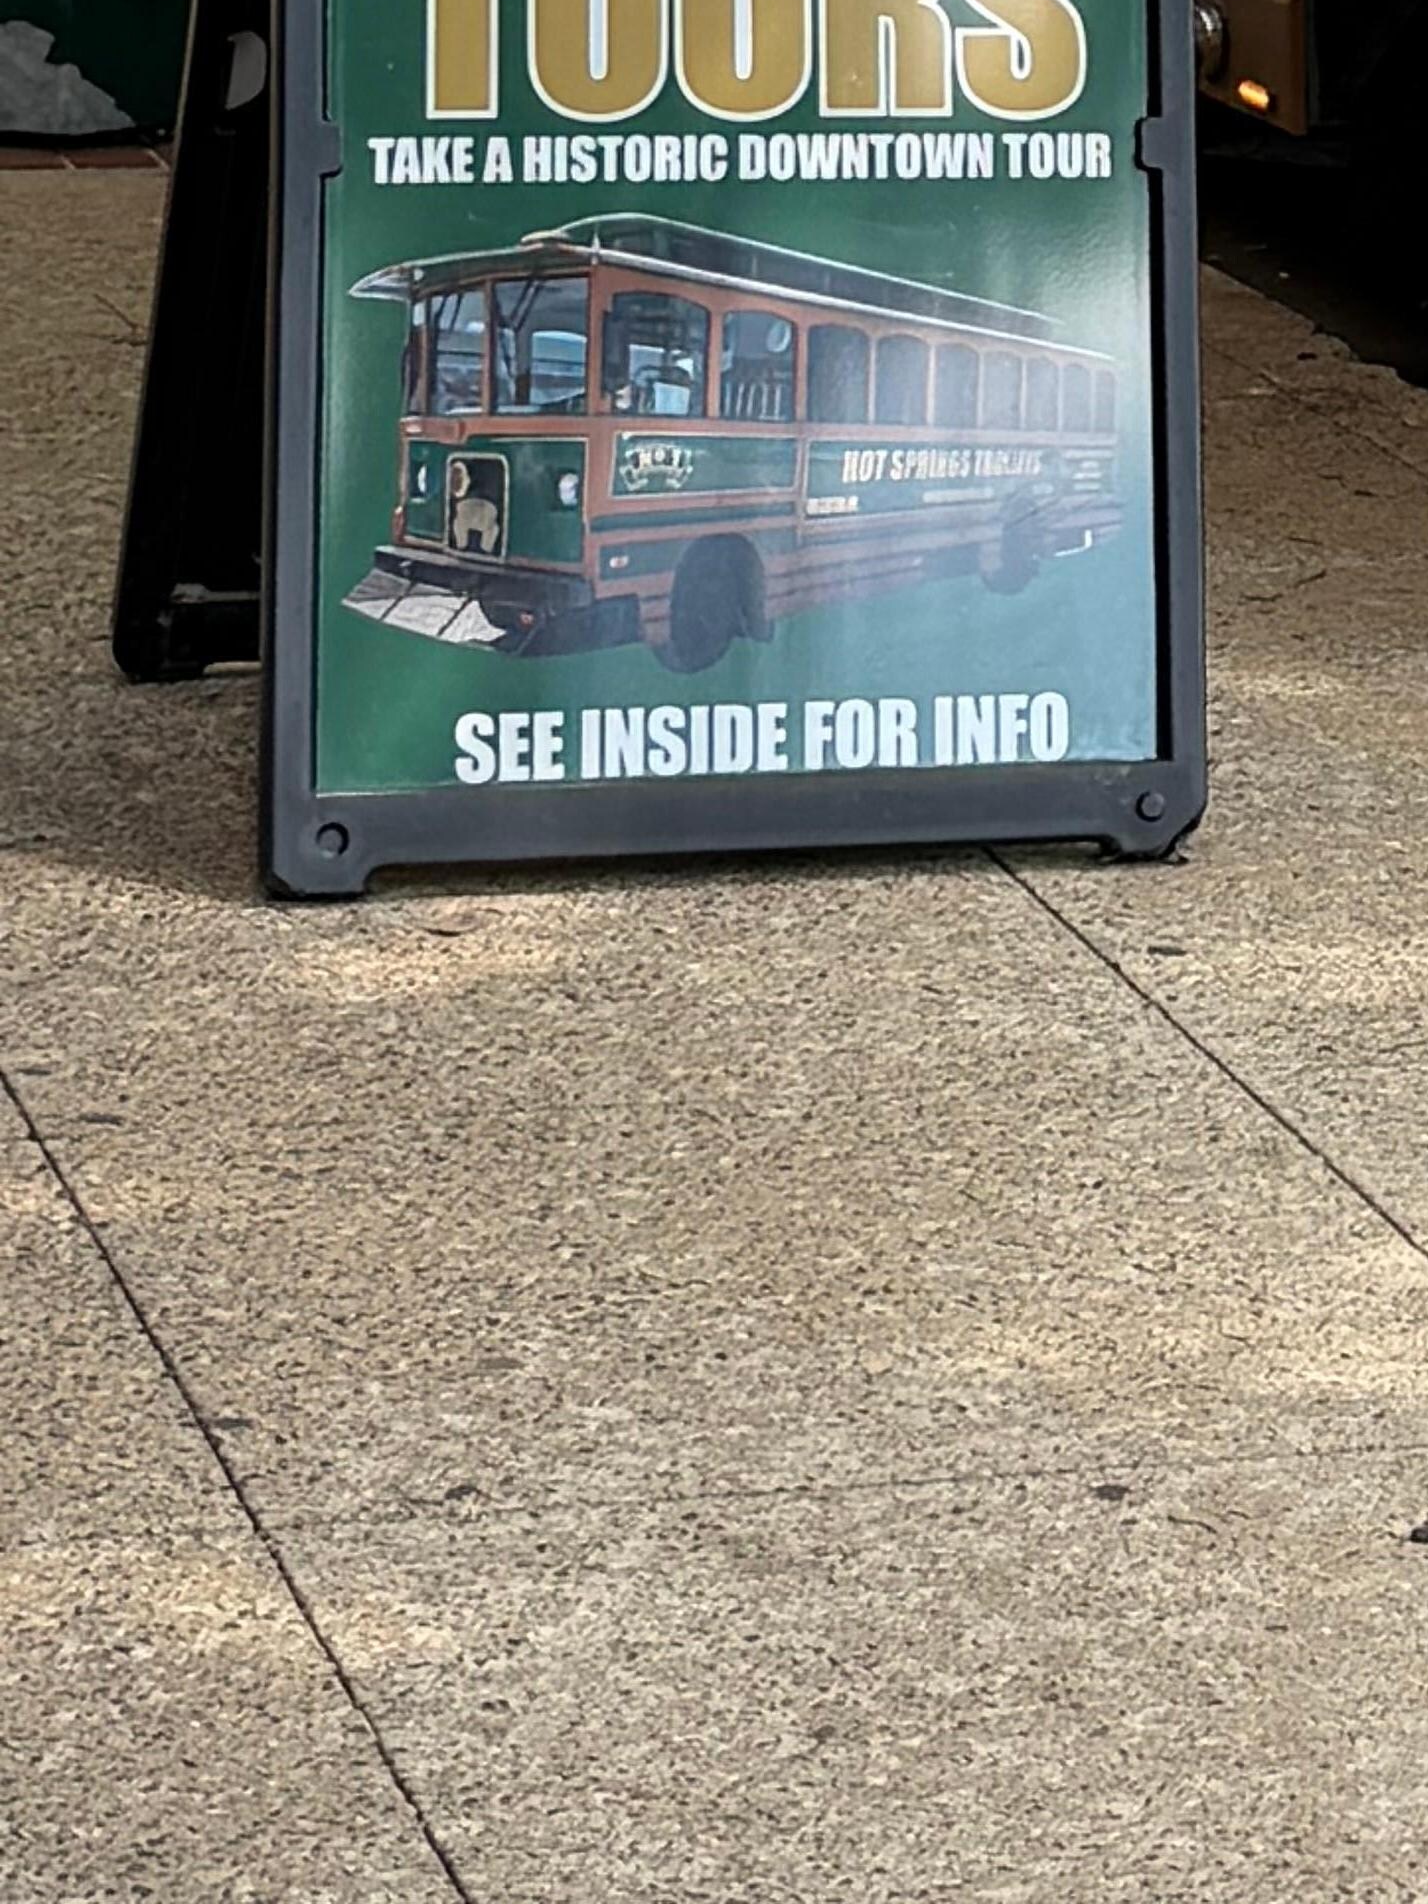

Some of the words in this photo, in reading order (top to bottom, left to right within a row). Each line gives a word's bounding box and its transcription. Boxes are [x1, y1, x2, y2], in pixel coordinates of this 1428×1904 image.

[368, 135, 473, 186] TAKE
[482, 135, 515, 184] A
[522, 133, 728, 183] HISTORIC
[737, 130, 995, 181] DOWNTOWN
[1002, 129, 1112, 179] TOUR
[841, 448, 885, 485] HOT
[890, 447, 972, 482] SPRINGS
[454, 710, 565, 785] SEE
[580, 702, 788, 779] INSIDE
[803, 697, 917, 769] FOR
[932, 691, 1069, 764] INFO
